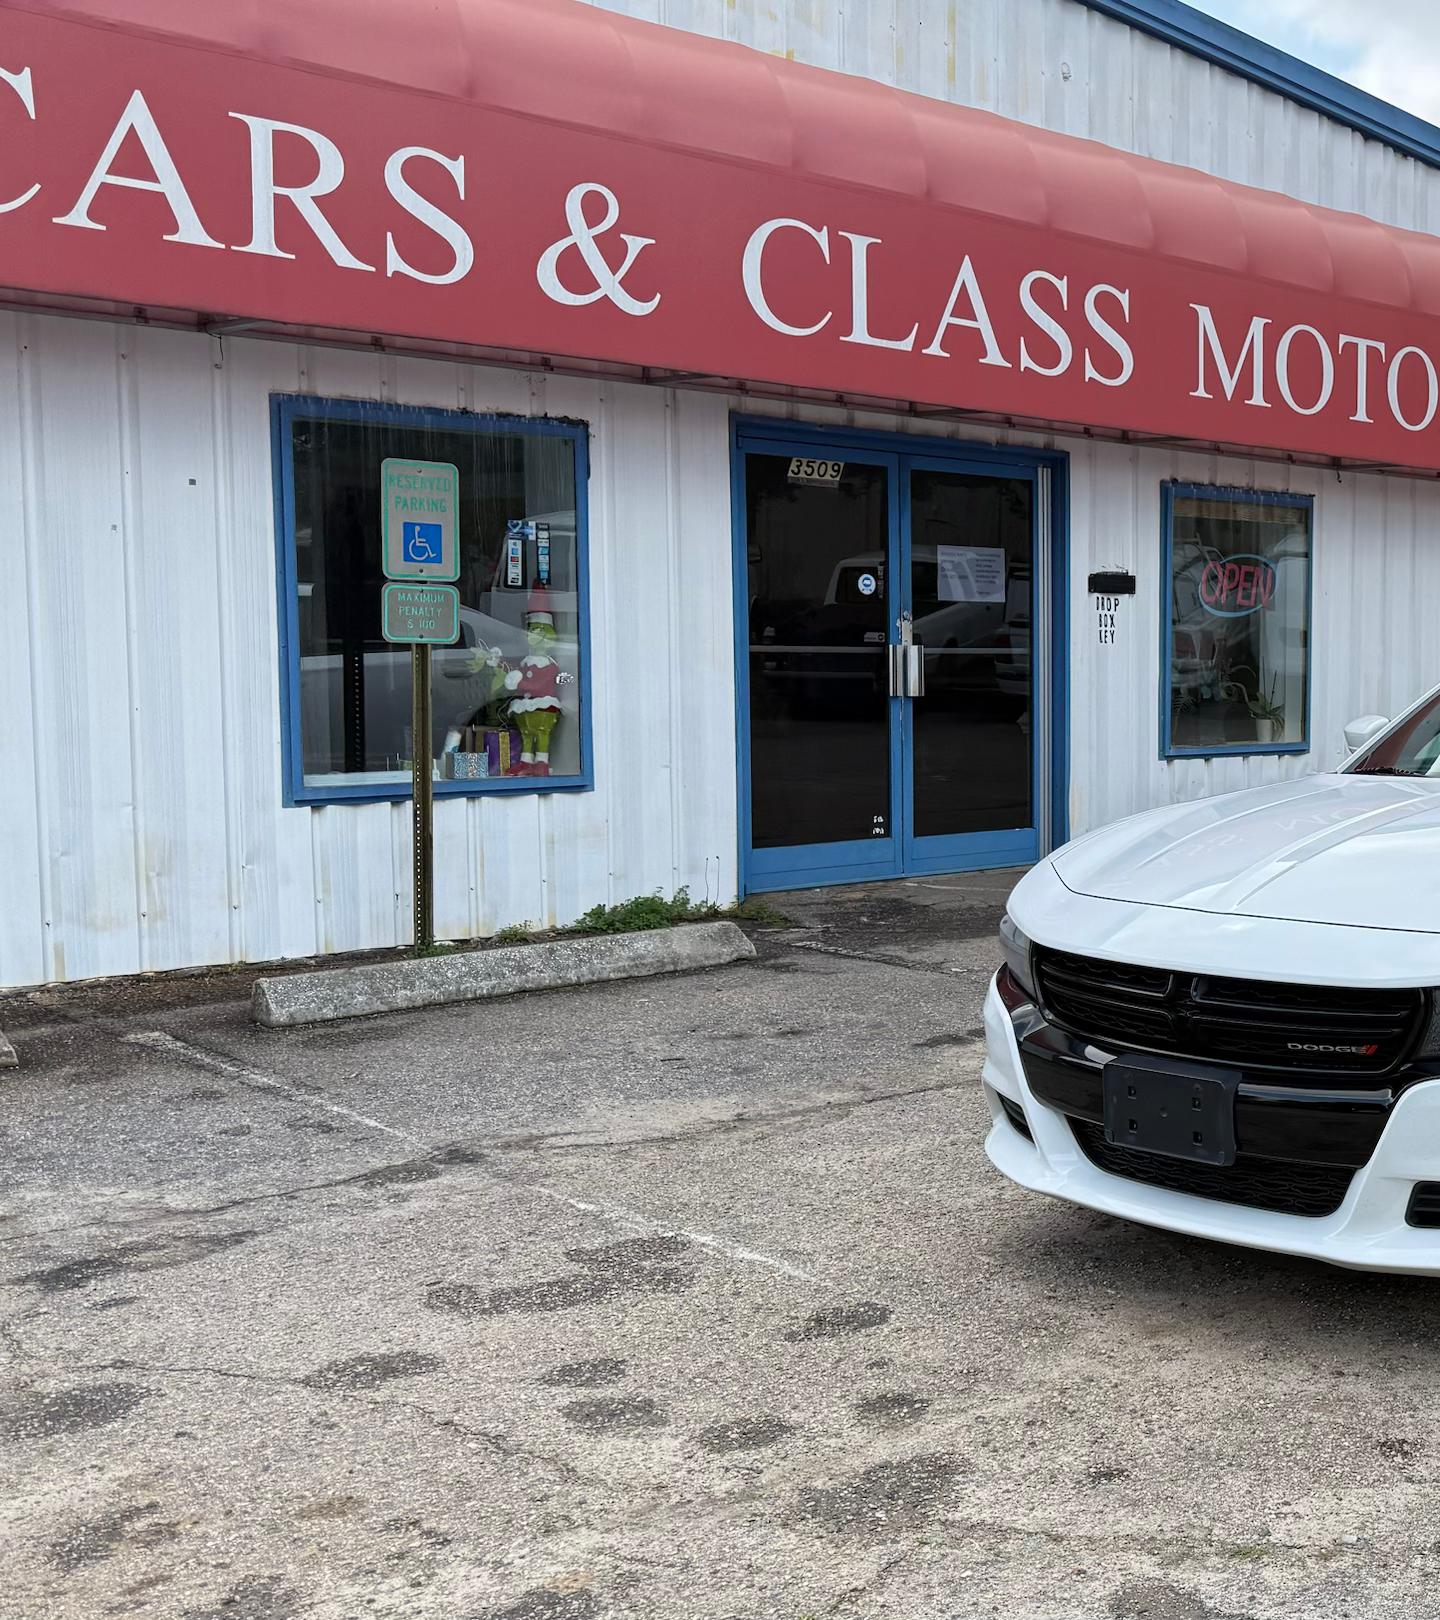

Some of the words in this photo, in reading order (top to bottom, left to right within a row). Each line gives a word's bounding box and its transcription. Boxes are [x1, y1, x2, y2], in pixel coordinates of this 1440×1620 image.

[536, 182, 661, 316] &
[742, 218, 1134, 387] CLASS
[791, 459, 841, 478] 3509
[394, 495, 448, 513] PARKING
[1201, 560, 1274, 608] OPEN
[397, 592, 445, 603] MAXIMUM
[1096, 596, 1120, 612] DROP
[398, 606, 442, 617] PENALTY
[1099, 613, 1116, 628] BOX
[1099, 629, 1115, 644] KEY
[1287, 1042, 1367, 1054] DODGE
